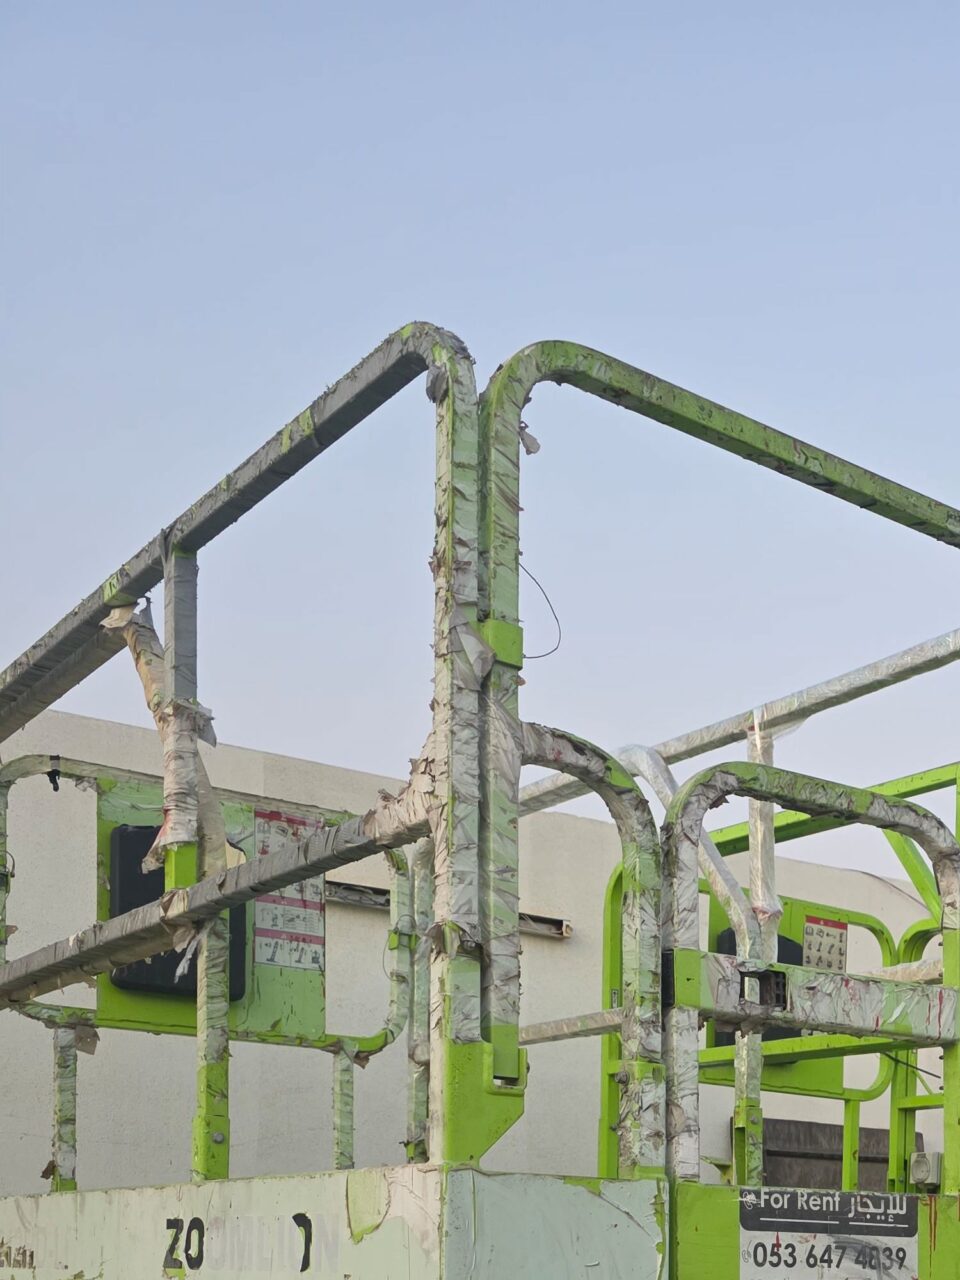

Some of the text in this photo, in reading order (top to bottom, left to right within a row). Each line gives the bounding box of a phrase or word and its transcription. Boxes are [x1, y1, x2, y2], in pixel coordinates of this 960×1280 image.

[760, 1190, 840, 1212] For Rent
[753, 1242, 907, 1270] 053 647 4839
